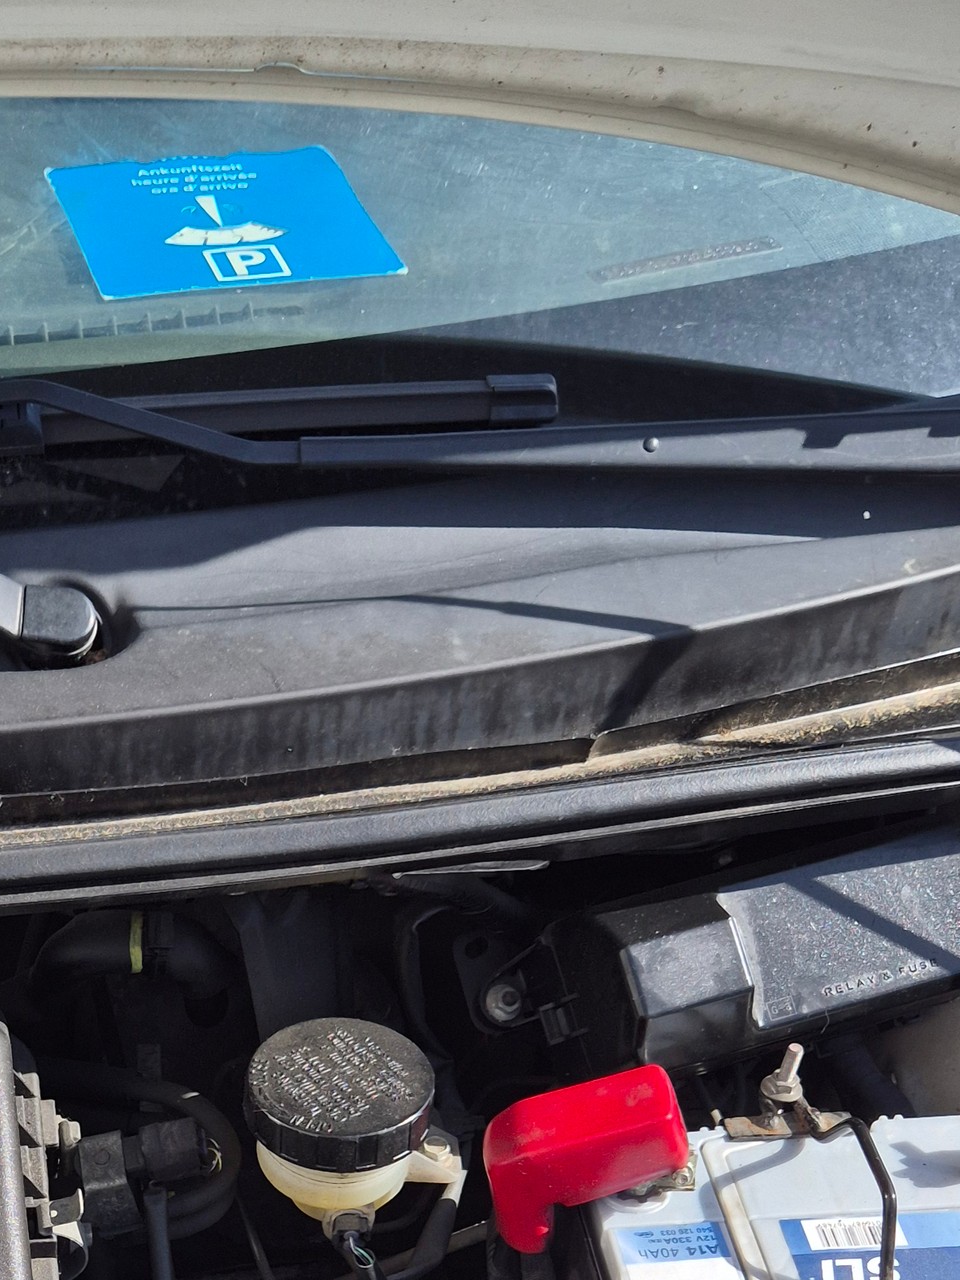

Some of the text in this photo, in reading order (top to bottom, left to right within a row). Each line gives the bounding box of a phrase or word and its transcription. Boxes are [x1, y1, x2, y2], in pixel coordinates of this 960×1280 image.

[131, 177, 179, 187] heure
[224, 249, 266, 277] P
[823, 958, 938, 997] RELAY & FUSE
[696, 1234, 718, 1243] 12V
[638, 1243, 721, 1260] A14 40Ah
